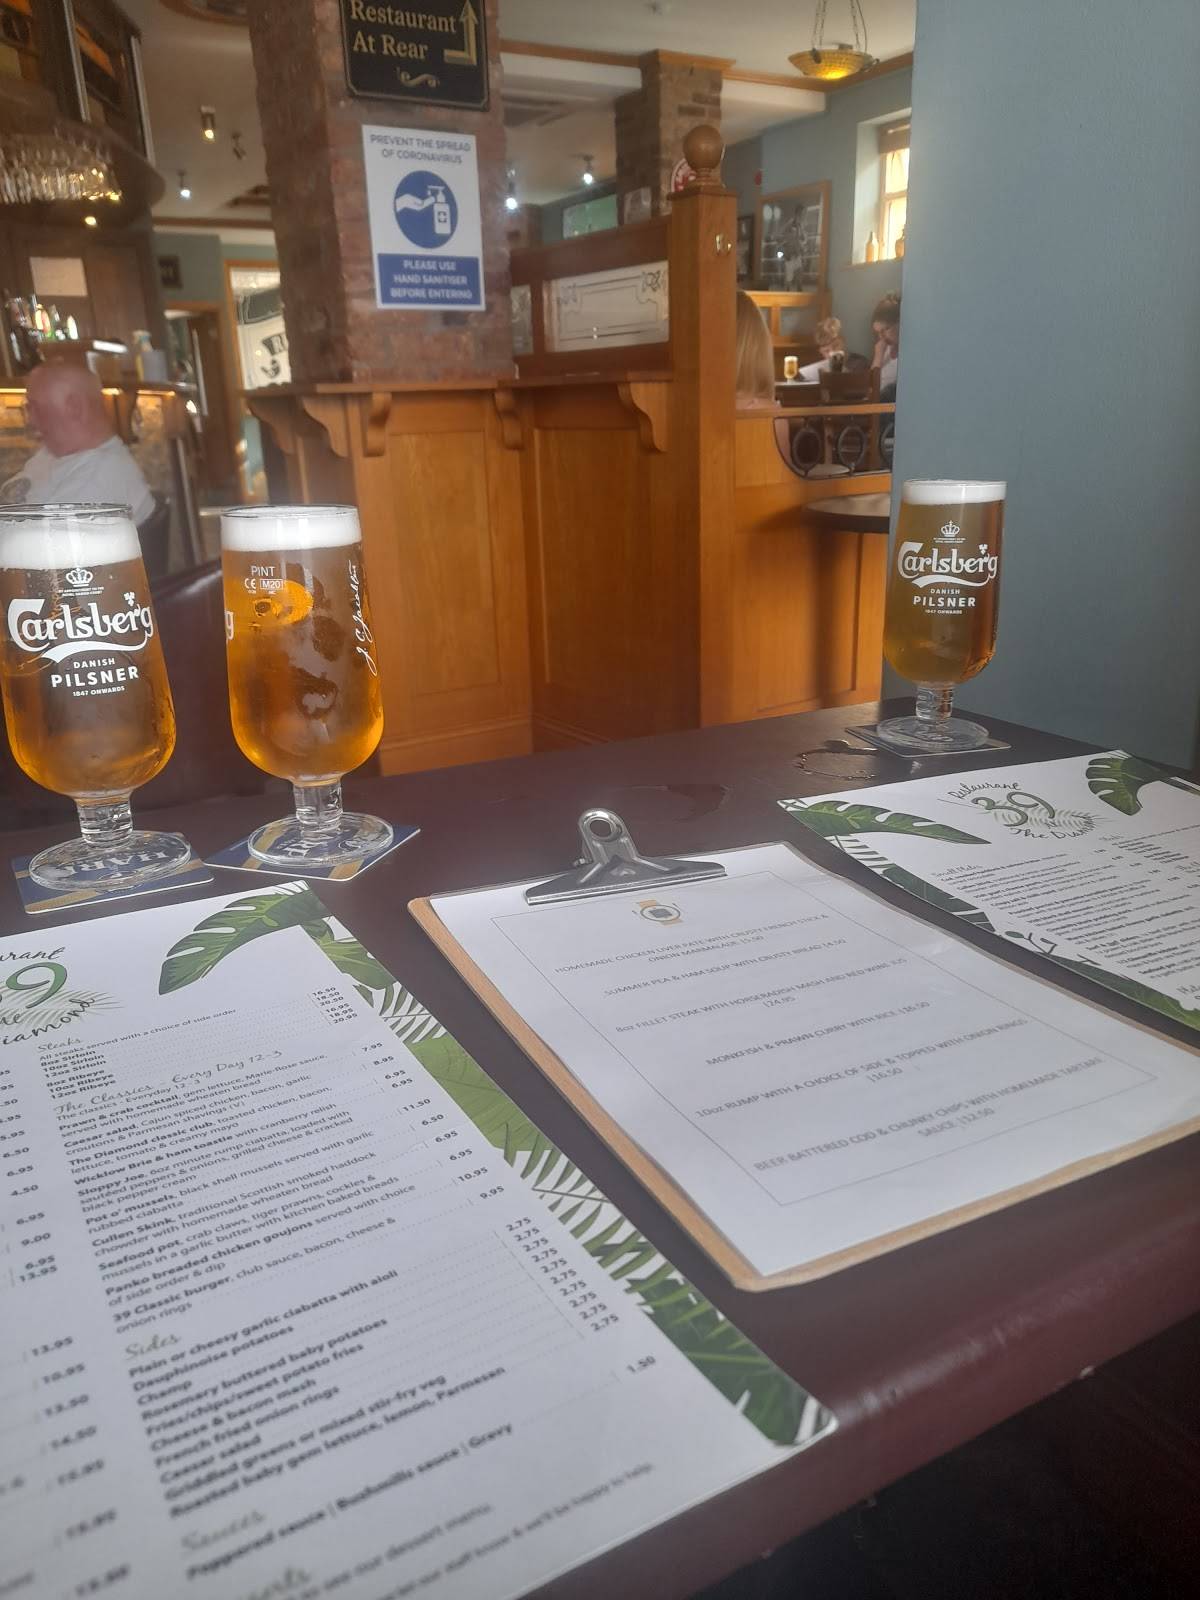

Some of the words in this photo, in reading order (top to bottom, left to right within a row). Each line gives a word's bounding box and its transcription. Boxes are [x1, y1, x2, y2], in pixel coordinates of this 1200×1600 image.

[351, 0, 456, 33] Restaurant
[353, 30, 376, 54] At
[382, 34, 428, 59] Rear
[370, 134, 413, 146] PREVENT
[416, 138, 433, 149] THE
[435, 139, 471, 152] SPREAD
[382, 148, 395, 158] OF
[397, 150, 462, 164] CORONAVIRUS
[403, 259, 437, 270] PLEASE
[439, 261, 456, 271] USE
[393, 274, 421, 284] HAND
[422, 274, 468, 285] SANITISER
[390, 287, 426, 298] BEFORE
[428, 288, 473, 300] ENTERING
[898, 542, 998, 579] Carlsberg
[251, 565, 276, 577] PINT
[913, 595, 976, 607] PILSNER
[8, 599, 154, 652] Carlsberg
[73, 658, 116, 669] DANISH
[51, 666, 139, 688] PILSNER
[91, 686, 125, 696] ONWARDS
[361, 1042, 382, 1051] 7.95
[43, 1063, 68, 1072] 10oz
[70, 1054, 104, 1065] Sirloin
[384, 1070, 405, 1079] 6.95
[391, 1078, 412, 1088] 6.95
[51, 1089, 77, 1099] 12oz
[79, 1080, 115, 1092] Ribeye
[58, 1118, 96, 1130] Prawn
[109, 1107, 133, 1116] crab
[136, 1094, 181, 1109] cocktail,
[182, 1088, 206, 1098] gem
[207, 1078, 244, 1091] lettuce,
[245, 1063, 297, 1080] Marie-Rose
[61, 1123, 97, 1137] served
[99, 1117, 123, 1126] with
[125, 1100, 185, 1119] homemade
[187, 1088, 230, 1102] wheaten
[231, 1078, 261, 1090] bread
[63, 1133, 102, 1147] Caesar
[106, 1123, 138, 1136] salad,
[140, 1114, 171, 1126] Cajun
[173, 1104, 206, 1117] spiced
[208, 1093, 250, 1107] chicken,
[250, 1084, 284, 1095] bacon,
[285, 1075, 311, 1086] garlic
[403, 1098, 430, 1111] 11.50
[68, 1156, 91, 1166] The
[93, 1139, 148, 1158] Diamond
[151, 1129, 186, 1142] classic
[189, 1121, 212, 1131] club,
[217, 1108, 256, 1123] toasted
[257, 1097, 297, 1112] chicken,
[298, 1087, 332, 1099] bacon,
[421, 1114, 444, 1125] 6.50
[74, 1167, 125, 1184] Wicklow
[128, 1159, 152, 1169] Brie
[165, 1147, 192, 1158] ham
[193, 1135, 232, 1149] toastie
[234, 1127, 258, 1137] with
[259, 1112, 308, 1130] cranberry
[310, 1103, 336, 1115] relish
[3, 1147, 29, 1158] 6.50
[77, 1180, 121, 1196] Sloppy
[124, 1173, 147, 1182] Joe,
[149, 1165, 170, 1174] 6oz
[172, 1153, 211, 1168] minute
[214, 1143, 243, 1155] rump
[245, 1131, 289, 1146] ciabatta,
[290, 1117, 326, 1132] loaded
[327, 1111, 349, 1120] with
[7, 1165, 33, 1176] 6.95
[457, 1167, 487, 1181] 10.95
[10, 1184, 39, 1196] 4.50
[91, 1230, 134, 1246] Cullen
[136, 1217, 176, 1232] Skink,
[177, 1195, 238, 1219] traditional
[239, 1182, 284, 1200] Scottish
[286, 1166, 329, 1184] smoked
[329, 1151, 376, 1170] haddock
[479, 1185, 504, 1199] 9.95
[124, 1194, 177, 1213] mussels,
[506, 1216, 531, 1231] 2.75
[21, 1232, 51, 1247] 9.00
[98, 1247, 154, 1270] Seafood
[157, 1239, 183, 1253] pot,
[105, 1277, 150, 1295] Panko
[152, 1255, 208, 1279] breaded
[211, 1239, 260, 1259] chicken
[263, 1221, 313, 1243] goujons
[19, 1265, 58, 1283] 13.95
[114, 1310, 131, 1321] 39
[134, 1294, 181, 1314] Classic
[183, 1276, 233, 1297] burger,
[579, 1302, 607, 1319] 2.75
[128, 1359, 167, 1377] Plain
[170, 1351, 185, 1362] or
[189, 1331, 238, 1354] cheesy
[241, 1316, 280, 1336] garlic
[283, 1294, 337, 1318] ciabatta
[339, 1282, 368, 1297] with
[370, 1270, 398, 1285] aioli
